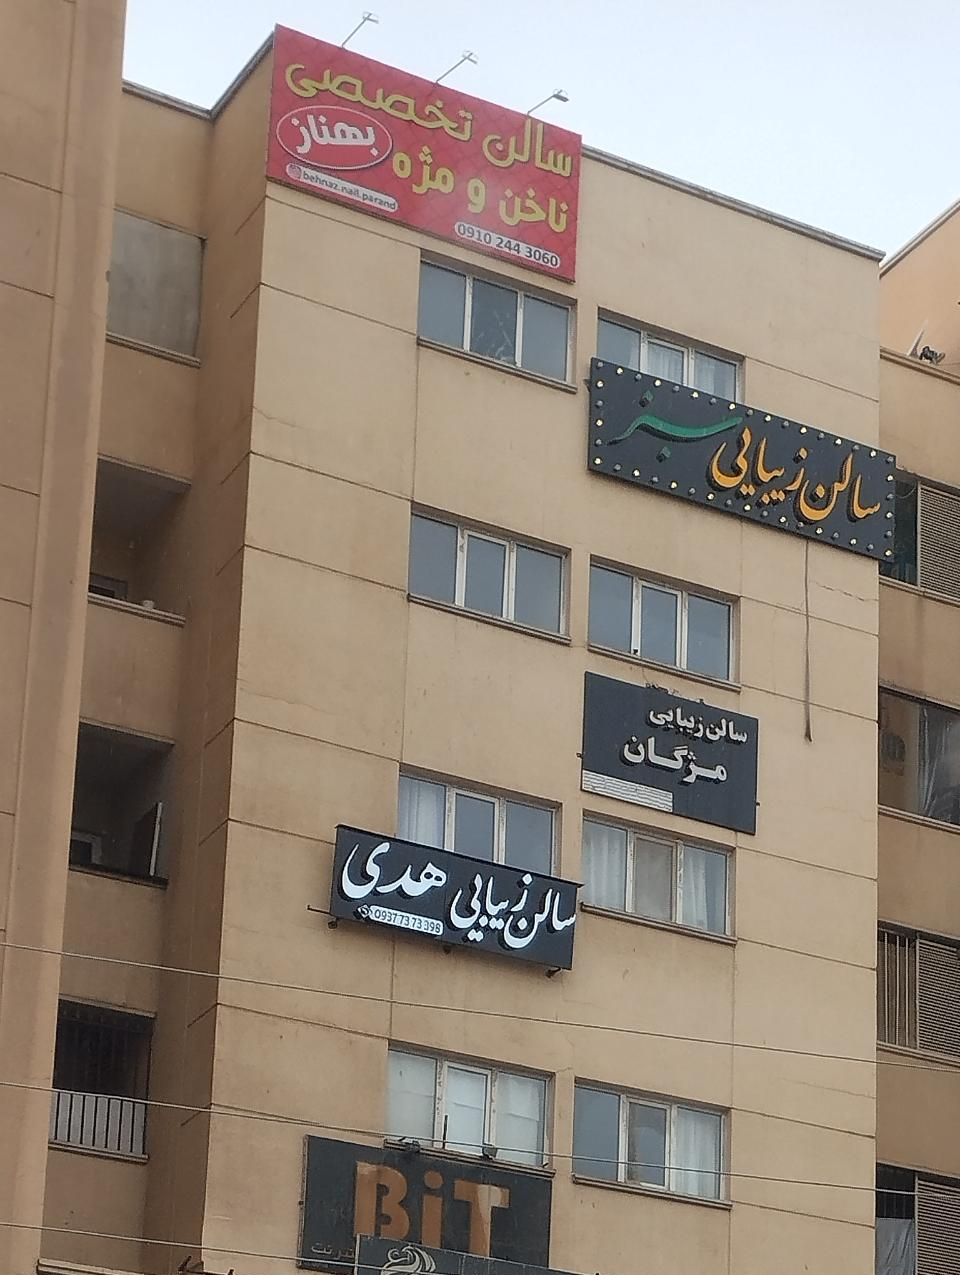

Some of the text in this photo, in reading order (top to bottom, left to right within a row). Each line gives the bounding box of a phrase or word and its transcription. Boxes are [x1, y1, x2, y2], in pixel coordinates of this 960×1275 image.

[285, 63, 572, 178] سالن تخصصی
[291, 113, 379, 157] بهناز
[391, 145, 569, 234] ناخن و مژه
[456, 222, 560, 268] 0910 244 3060
[708, 426, 806, 506] زیبایی
[798, 453, 881, 522] سالن
[623, 733, 728, 784] مژگان
[649, 707, 748, 743] سالن زیبایی
[341, 841, 576, 949] سالن زیبایی هدی
[354, 1161, 511, 1258] BiT
